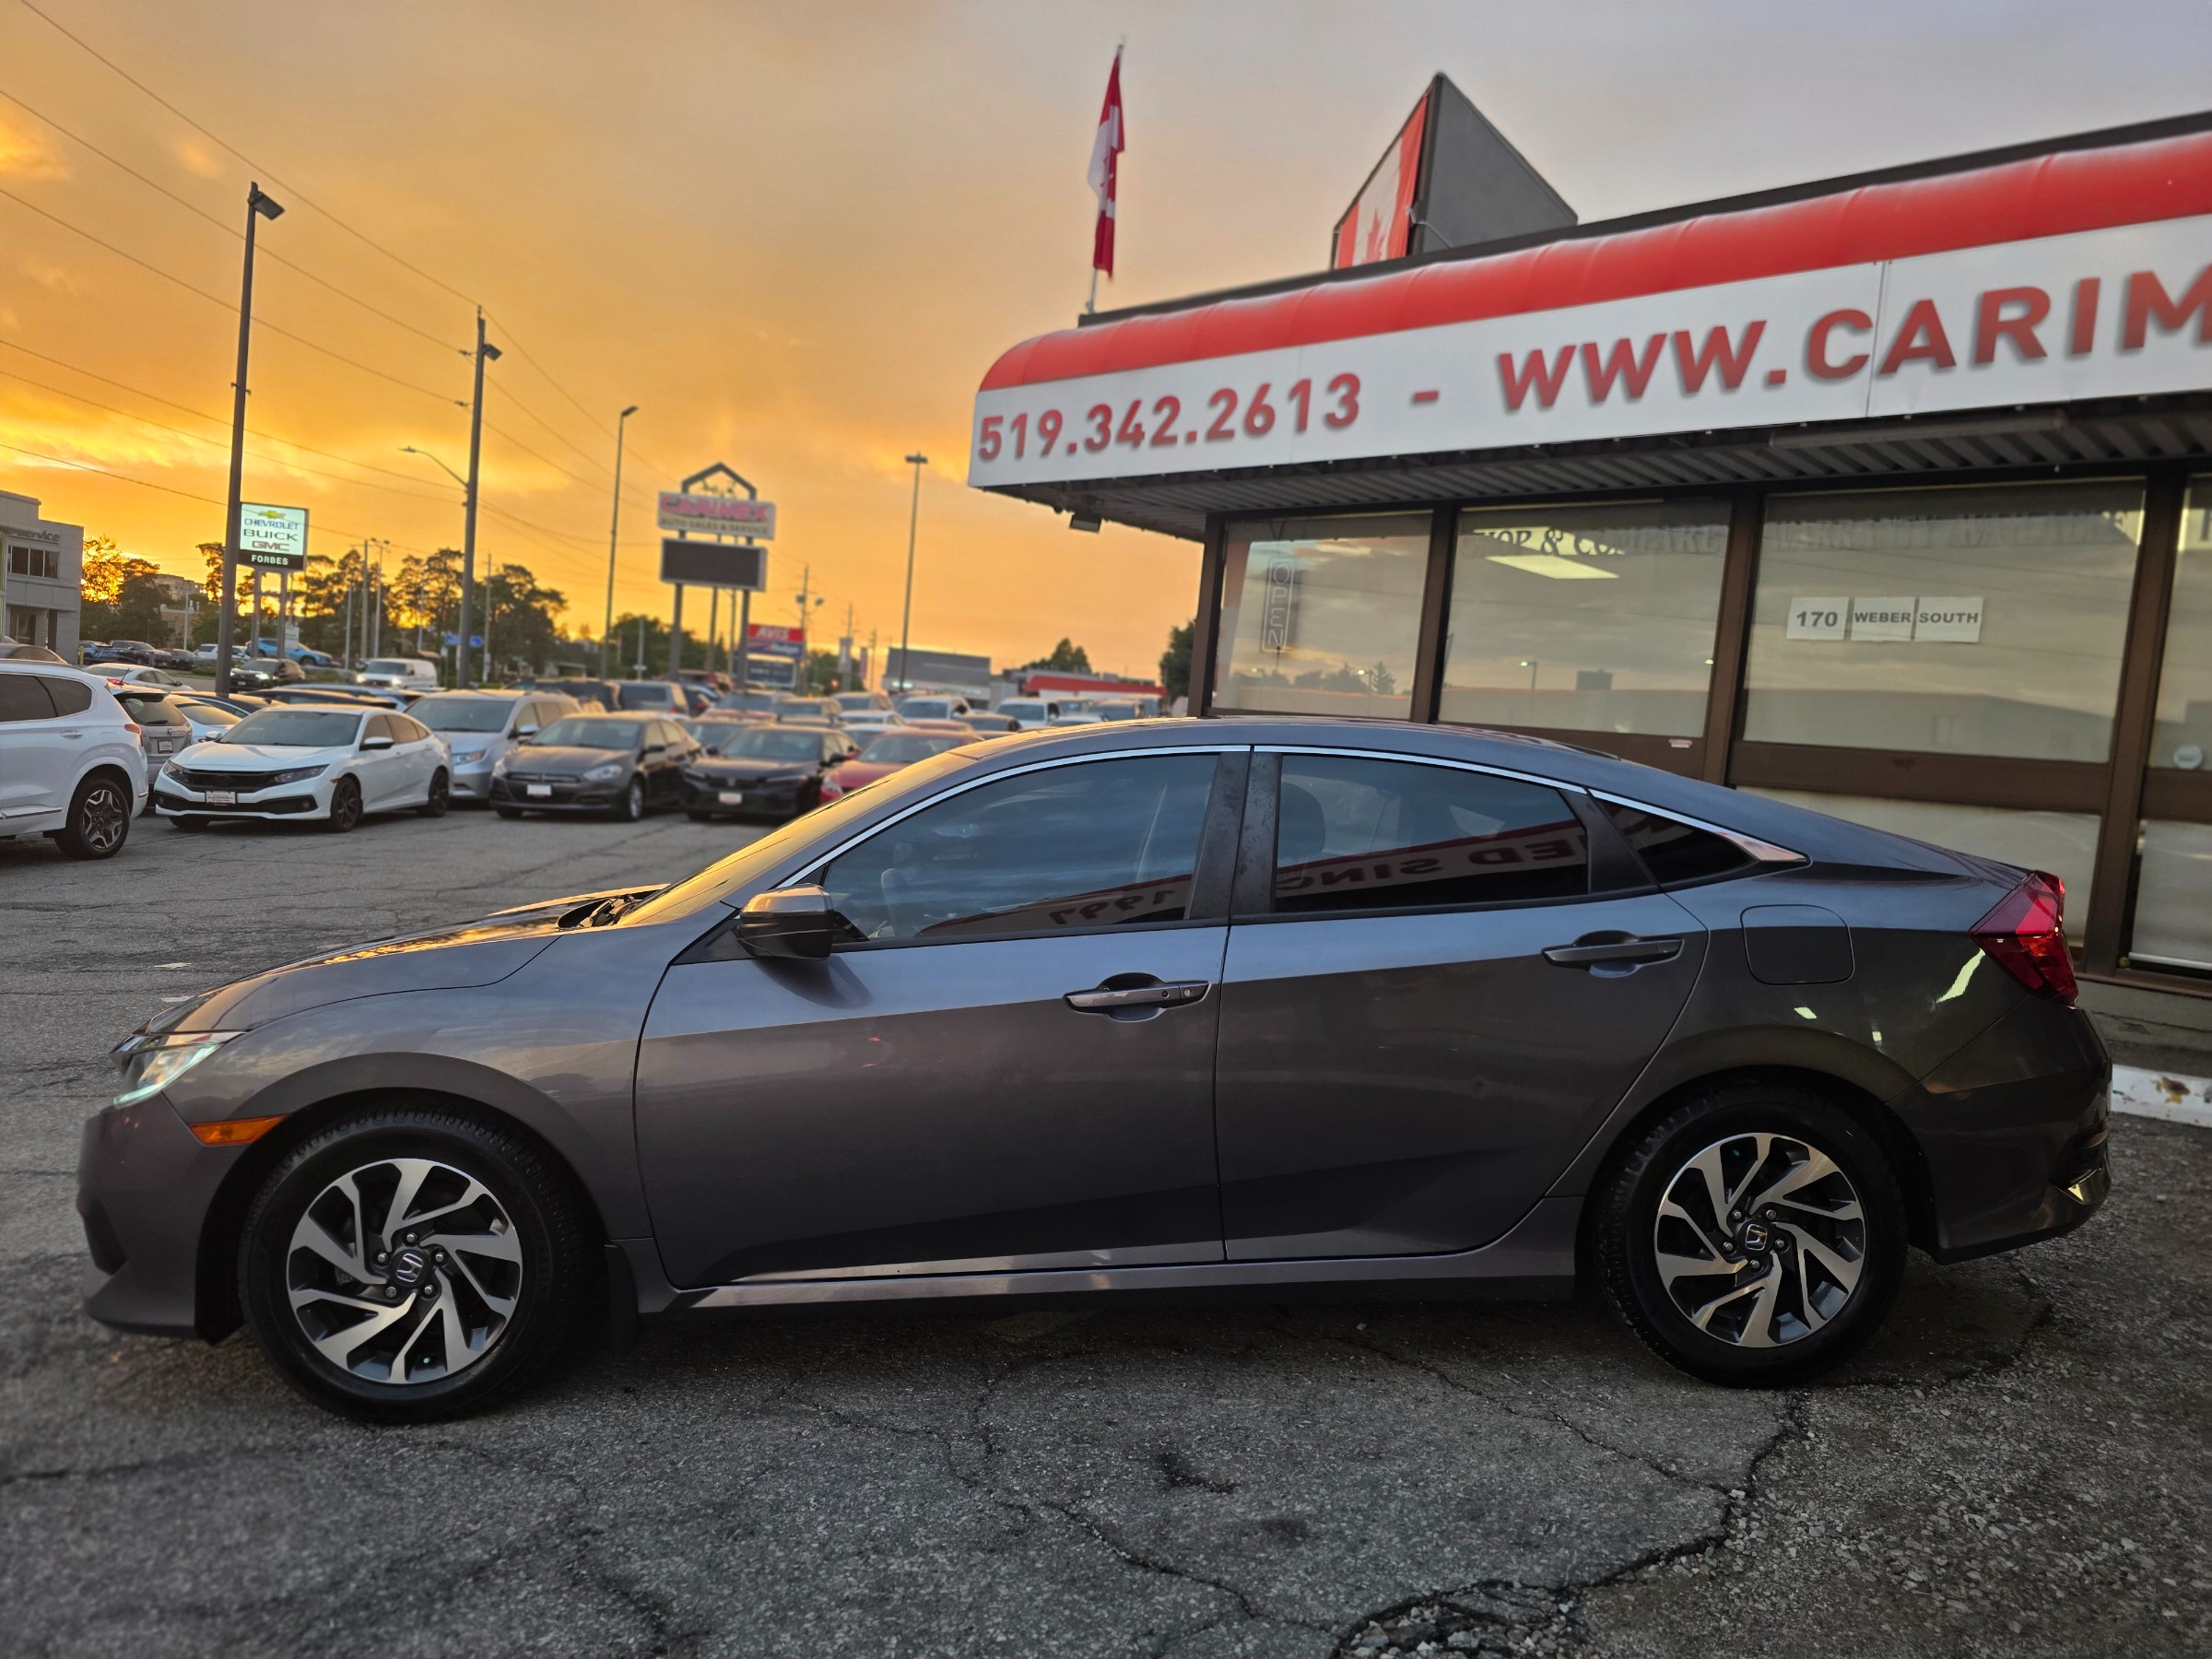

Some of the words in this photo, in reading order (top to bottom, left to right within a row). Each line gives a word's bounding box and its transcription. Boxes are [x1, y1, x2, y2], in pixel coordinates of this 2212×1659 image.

[978, 372, 1361, 461] 519.342.2613
[1497, 263, 2212, 412] WWW.CARIM
[244, 518, 300, 530] CHEVROLET
[243, 529, 298, 542] BUICK
[252, 541, 289, 551] GMC
[251, 555, 288, 565] FORBES
[1267, 565, 1290, 646] OPEN
[1796, 611, 1838, 628] 170
[1854, 612, 1912, 624] WEBER
[1919, 612, 1979, 624] SOUTH
[757, 627, 789, 641] AVIS
